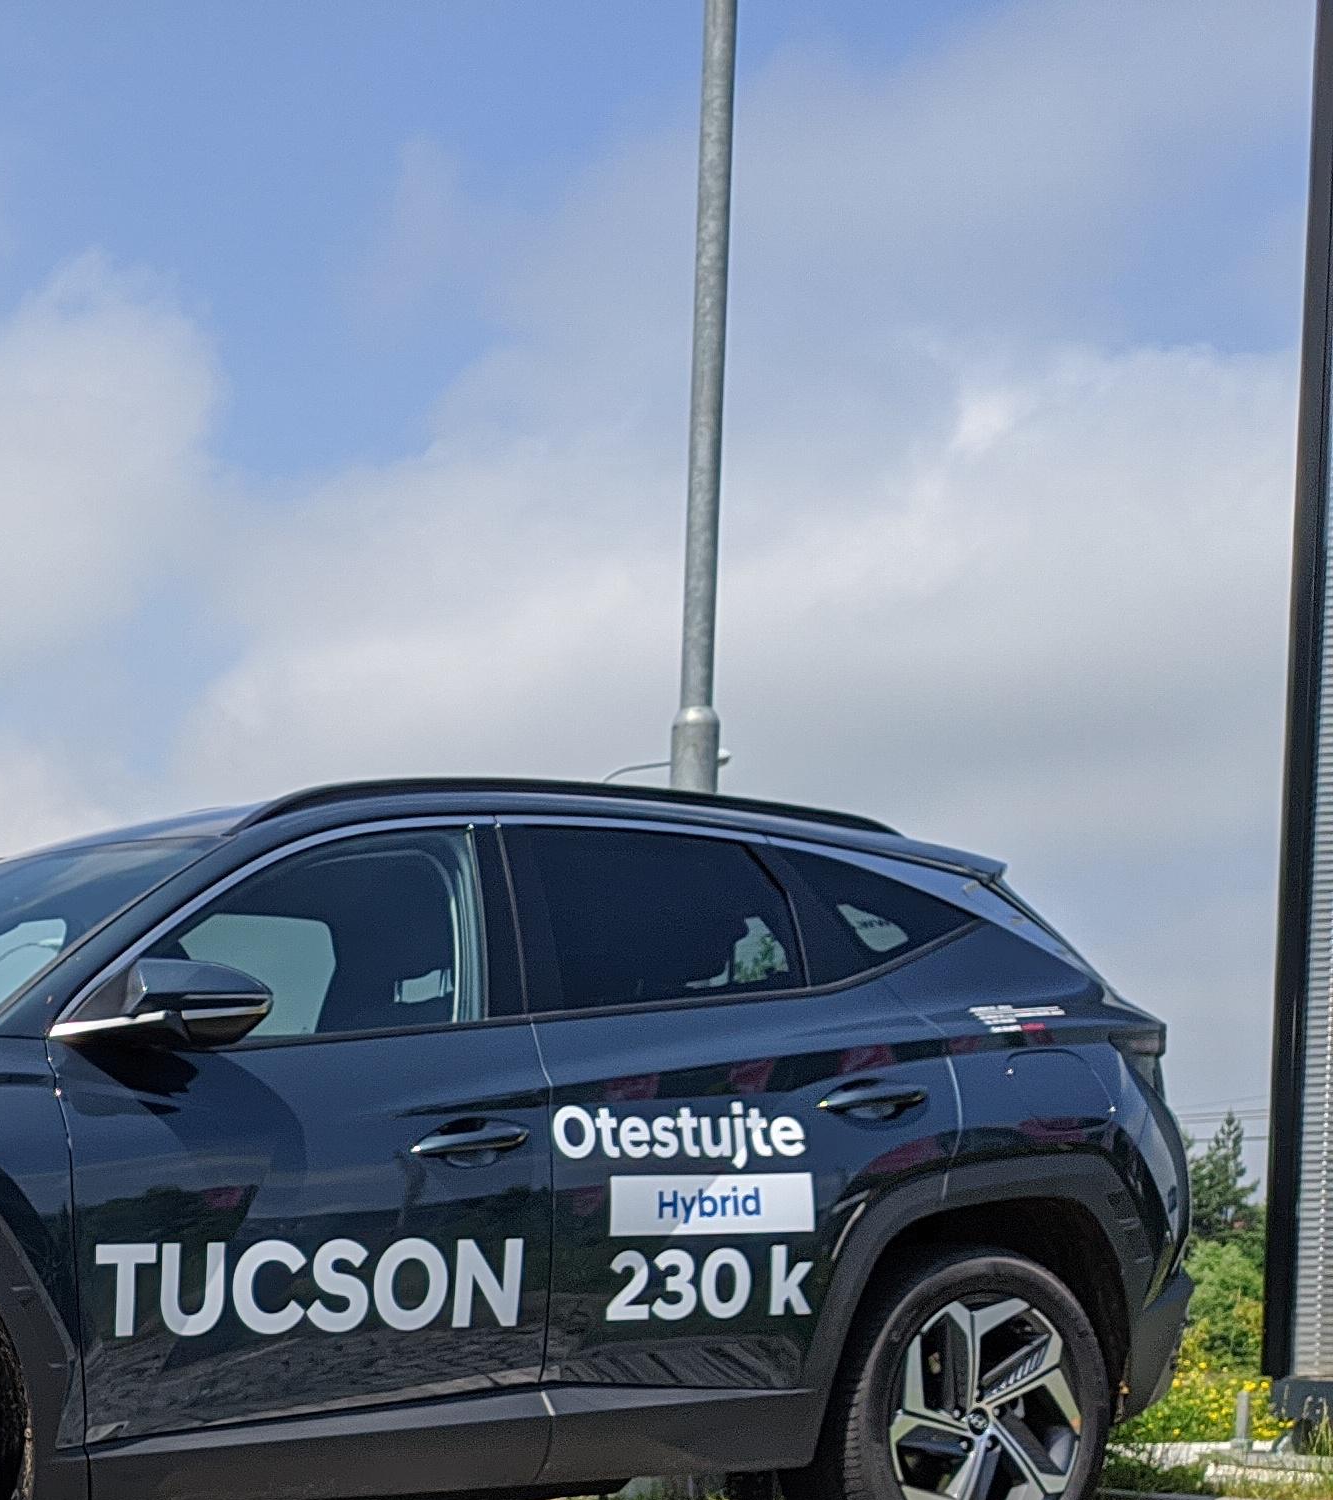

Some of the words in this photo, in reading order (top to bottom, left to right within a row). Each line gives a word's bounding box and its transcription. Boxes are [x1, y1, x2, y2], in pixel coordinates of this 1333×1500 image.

[552, 1102, 806, 1169] Otestujte
[657, 1186, 763, 1222] Hybrid
[95, 1238, 524, 1337] TUCSON
[606, 1248, 750, 1322] 230
[770, 1245, 813, 1316] k
